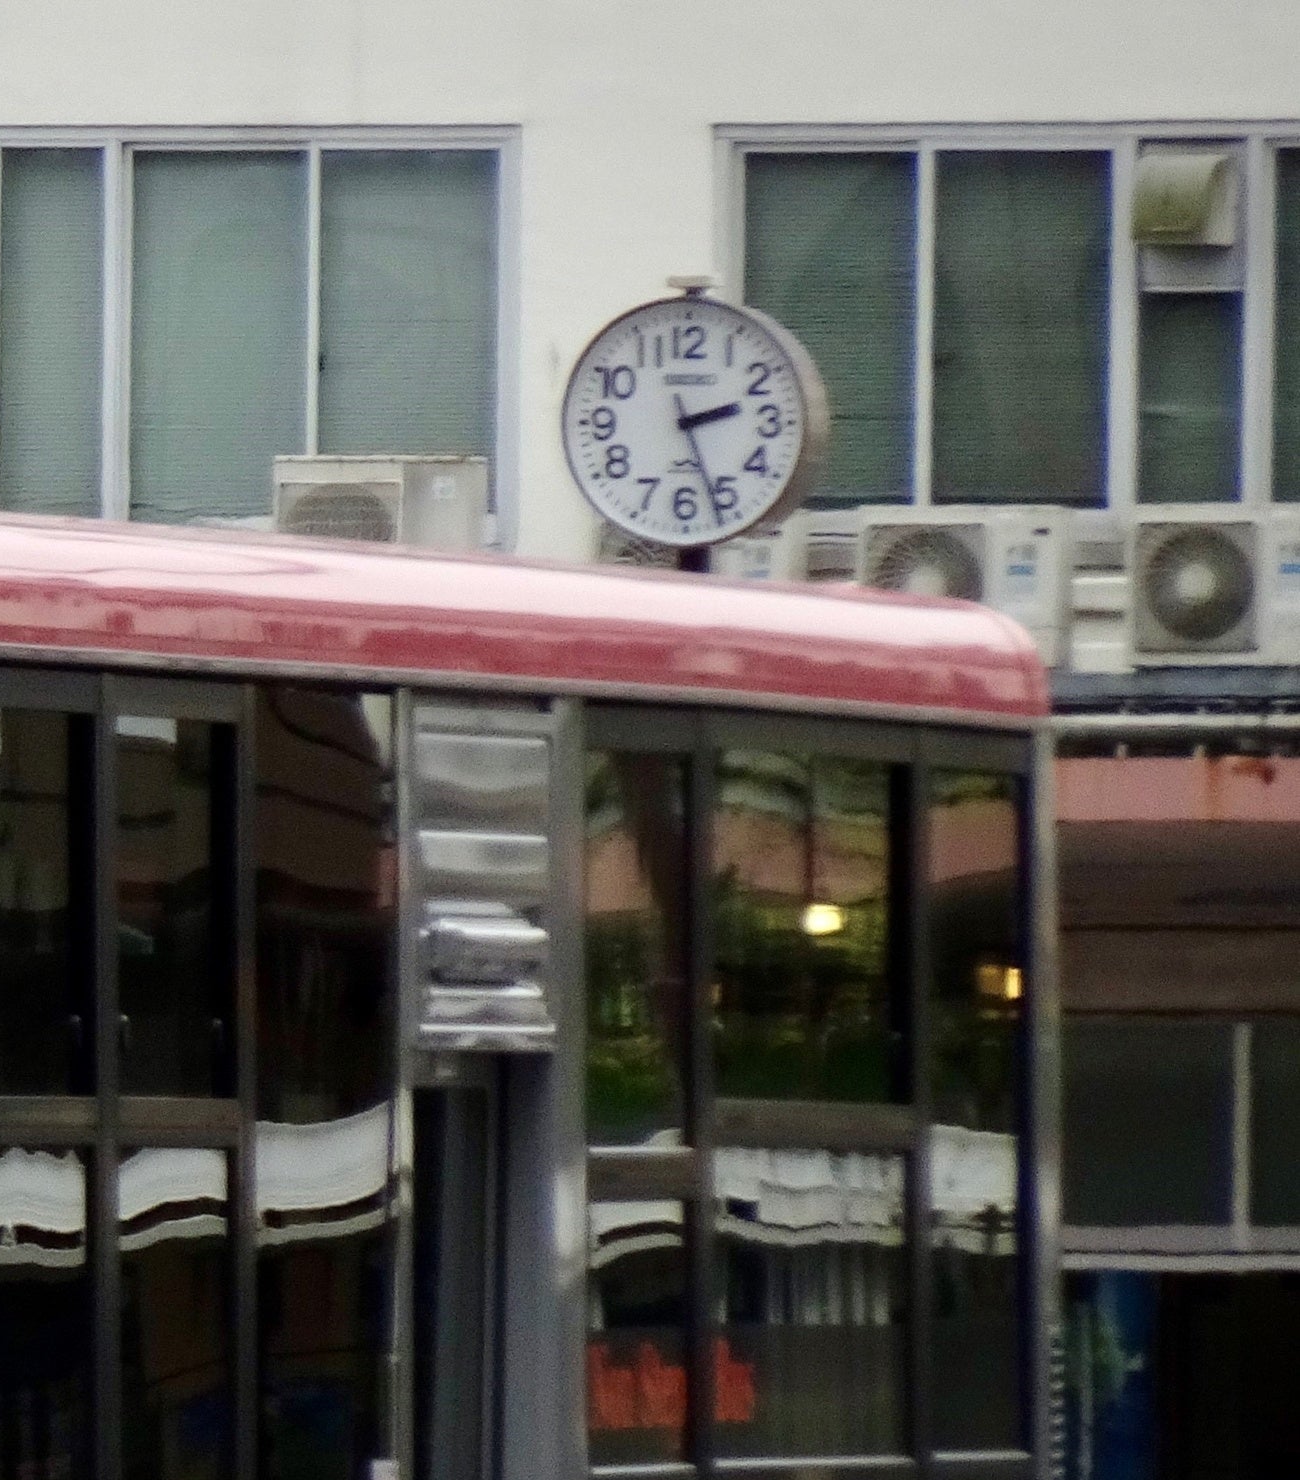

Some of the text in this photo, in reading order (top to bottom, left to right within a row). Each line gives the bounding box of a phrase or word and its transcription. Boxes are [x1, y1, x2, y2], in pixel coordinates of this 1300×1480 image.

[637, 333, 663, 368] 11
[672, 326, 707, 359] 12
[725, 334, 735, 367] 1
[594, 365, 637, 400] 10
[746, 362, 772, 396] 2
[592, 407, 617, 441] 9
[756, 404, 782, 438] 3
[604, 444, 630, 479] 8
[743, 445, 768, 478] 4
[637, 477, 661, 511] 7
[672, 486, 698, 521] 6
[714, 475, 738, 511] 5
